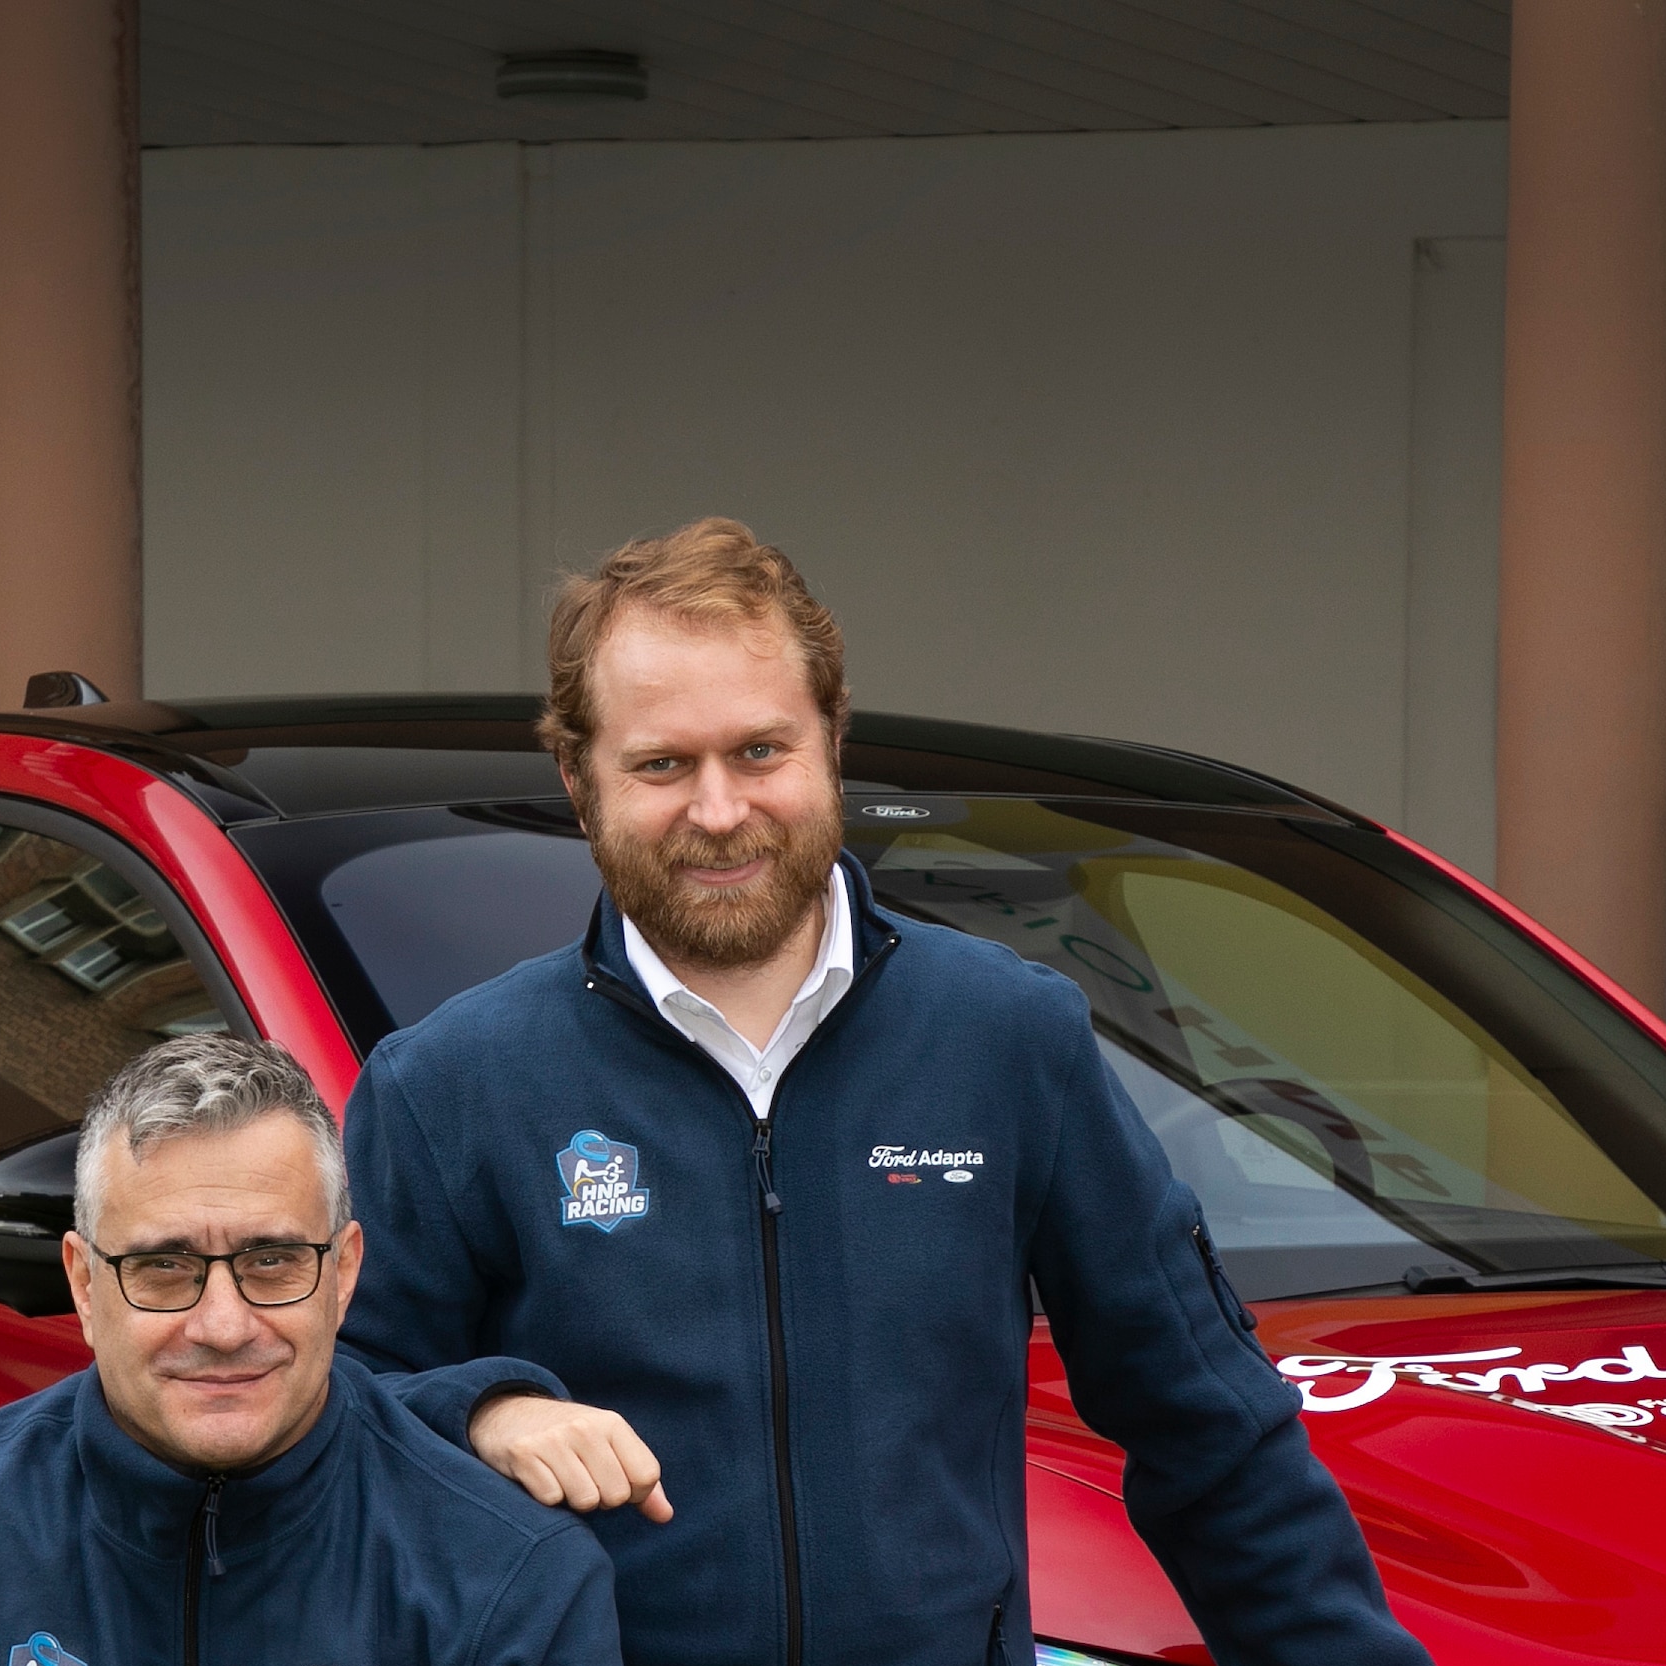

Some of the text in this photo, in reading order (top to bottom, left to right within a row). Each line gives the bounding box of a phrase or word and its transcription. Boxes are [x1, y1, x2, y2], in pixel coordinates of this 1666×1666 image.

[876, 806, 919, 816] Ford
[869, 1145, 984, 1168] Ford Adapta
[581, 1181, 630, 1202] HNP
[566, 1194, 647, 1220] RACING
